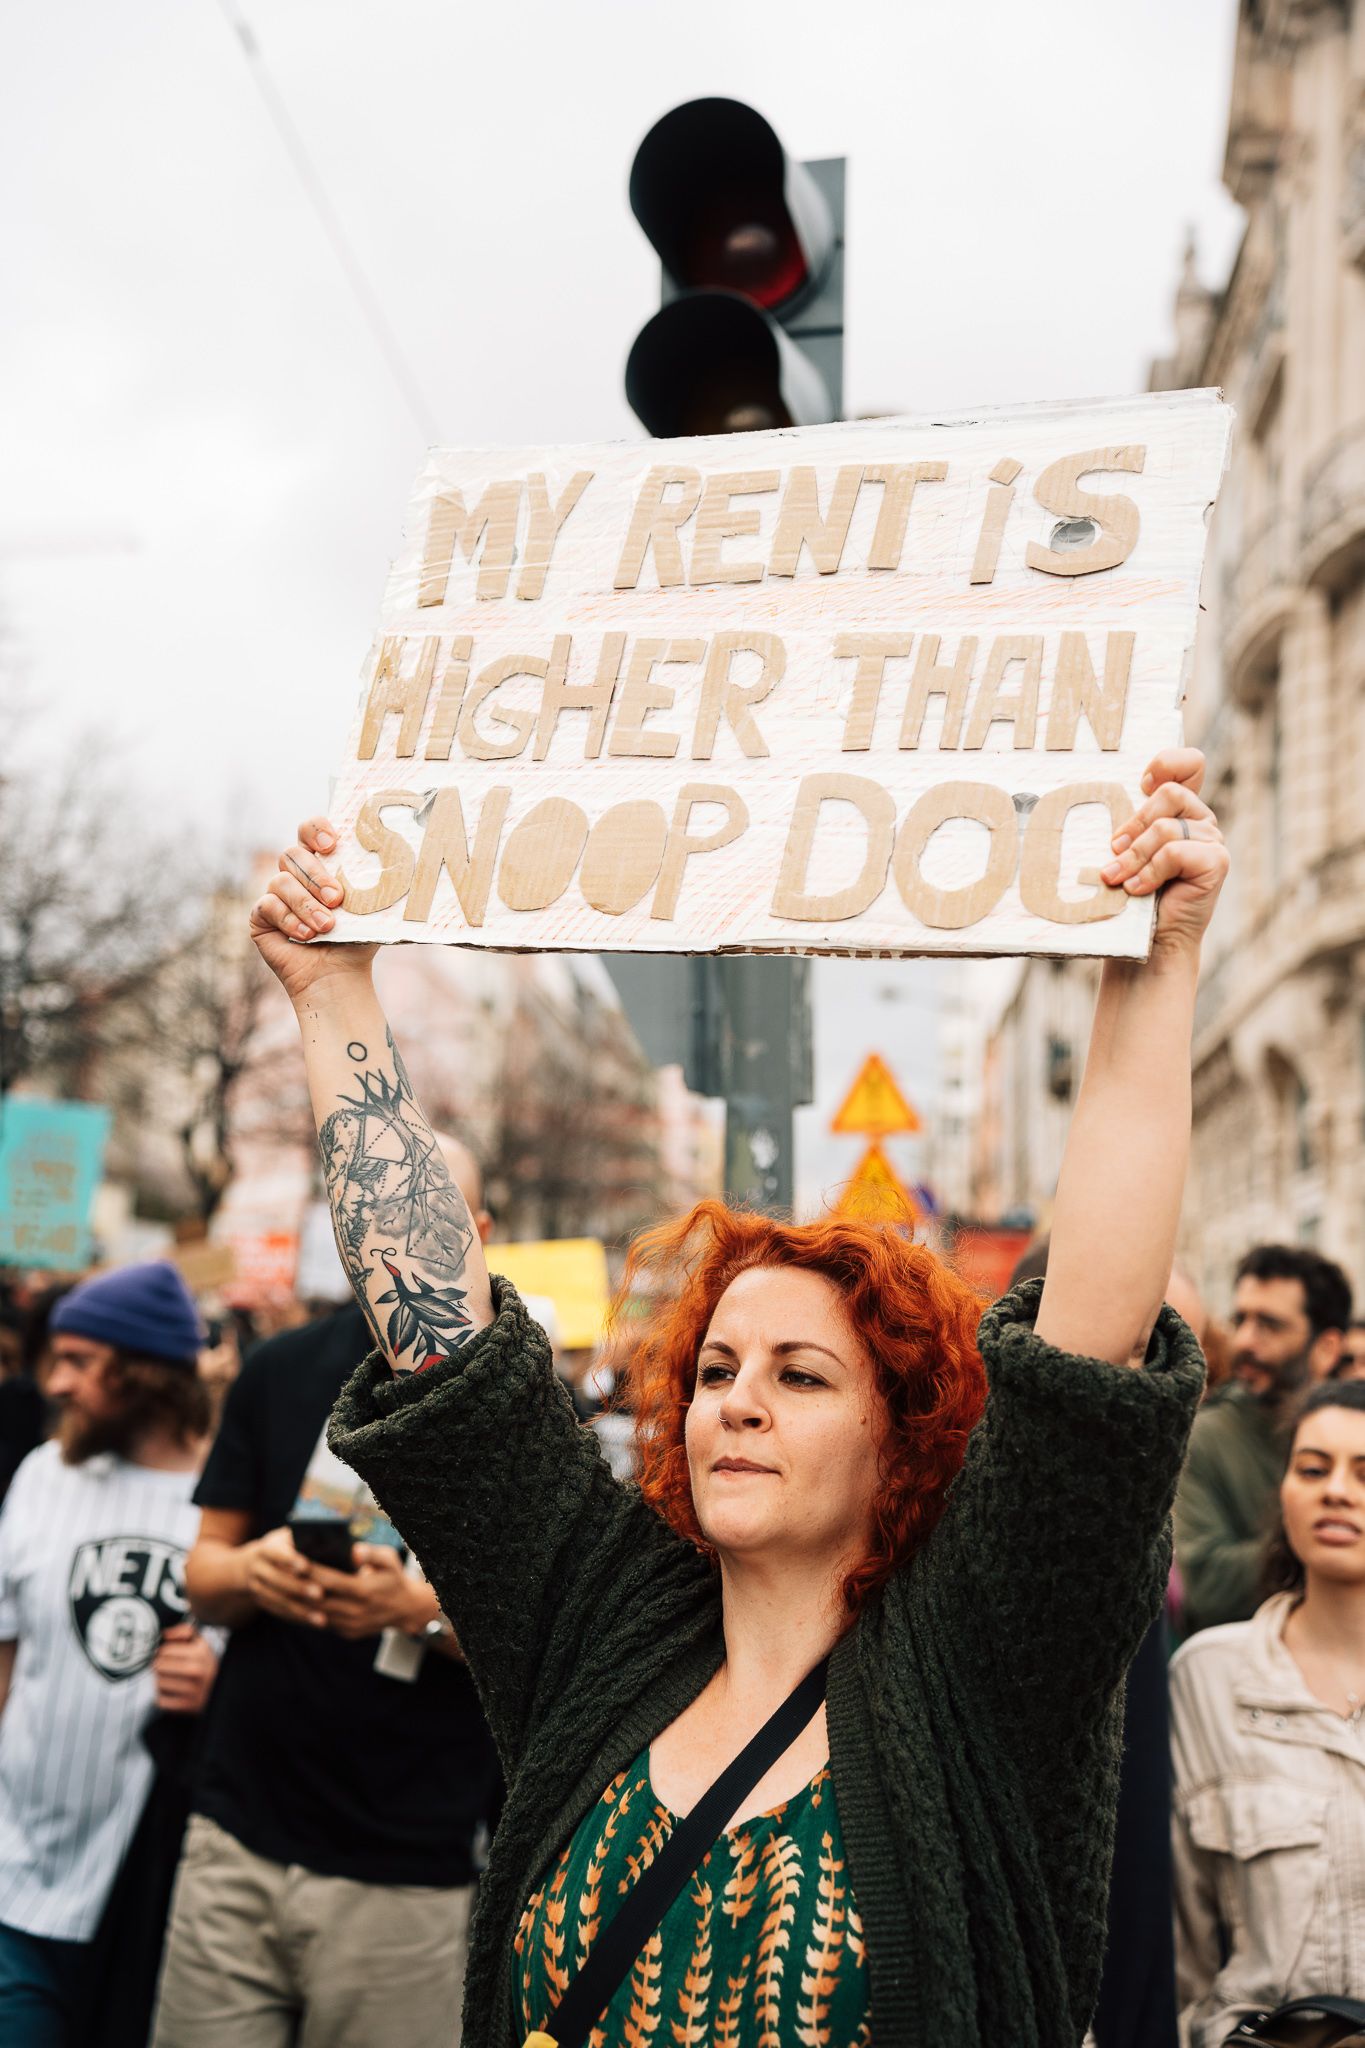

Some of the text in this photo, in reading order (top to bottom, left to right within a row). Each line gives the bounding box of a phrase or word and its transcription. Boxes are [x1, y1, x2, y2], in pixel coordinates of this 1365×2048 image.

[417, 470, 595, 608] MY
[613, 460, 949, 589] RENT
[833, 630, 1137, 752] THAN
[336, 772, 1137, 930] SNOOP DOG
[70, 1542, 192, 1613] NETS
